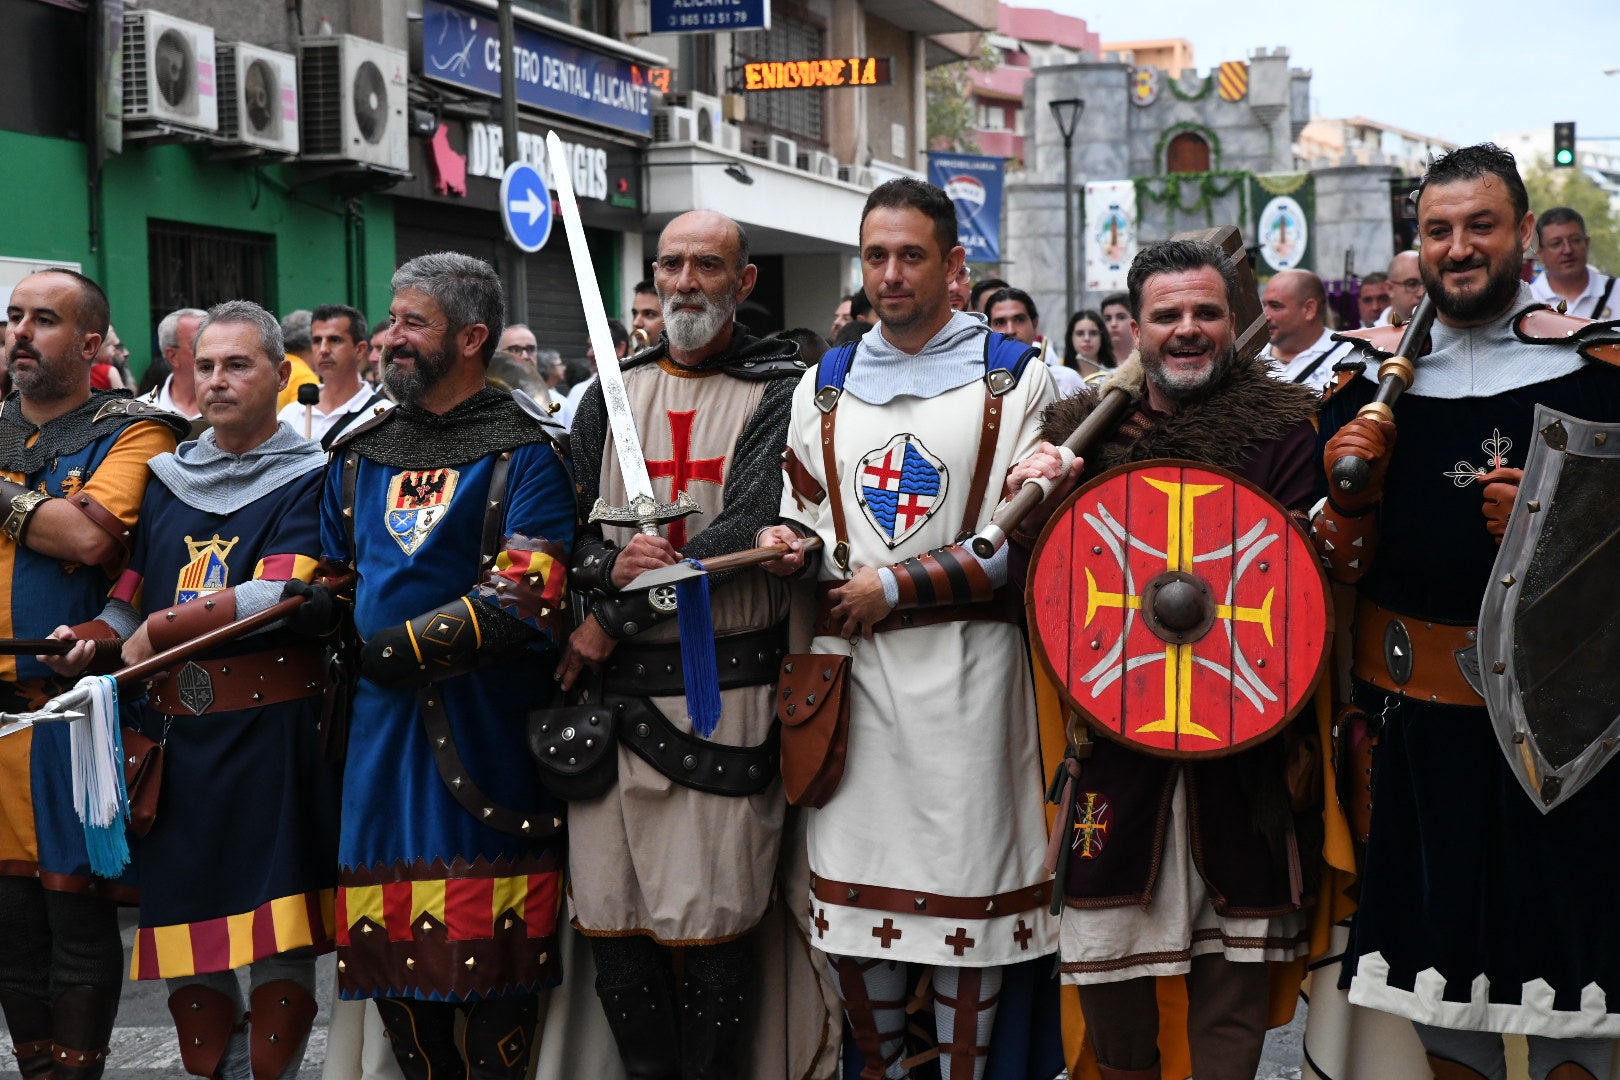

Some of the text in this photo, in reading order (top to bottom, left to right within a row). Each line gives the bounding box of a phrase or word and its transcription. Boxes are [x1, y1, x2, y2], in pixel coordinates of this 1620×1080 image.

[484, 36, 540, 84] CETRO
[543, 56, 591, 99] DENTAL
[593, 72, 649, 116] ALICANTE
